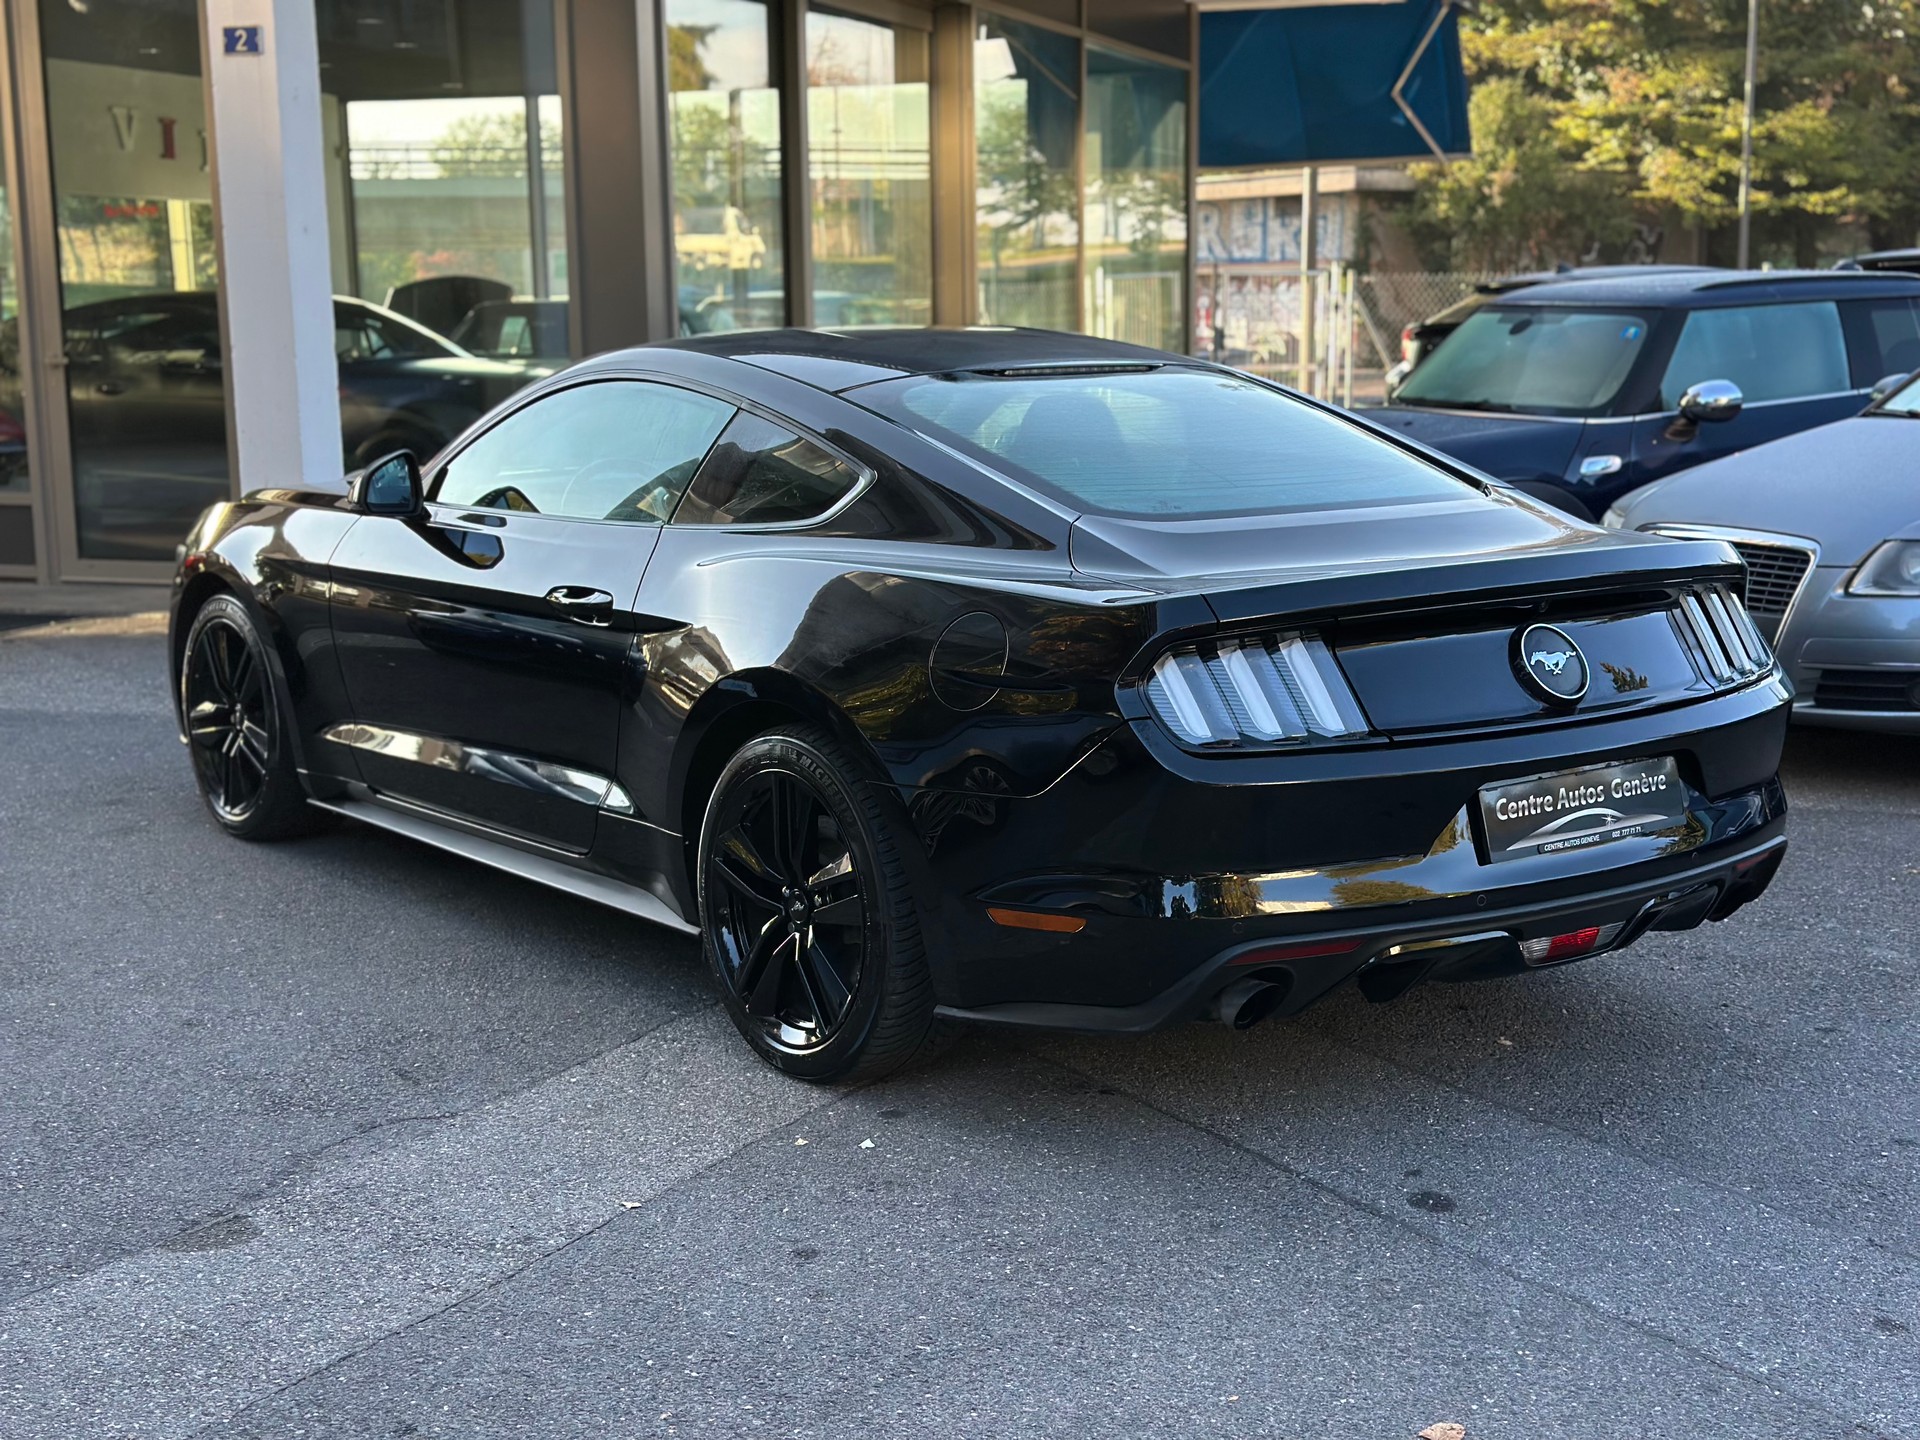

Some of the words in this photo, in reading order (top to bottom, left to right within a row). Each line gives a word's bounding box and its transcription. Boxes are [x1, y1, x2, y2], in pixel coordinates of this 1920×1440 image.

[234, 28, 249, 52] 2
[1495, 795, 1554, 821] Centre
[1557, 785, 1605, 810] Autos
[1610, 773, 1667, 799] Genève
[1544, 842, 1564, 851] CENTRE
[1564, 838, 1580, 848] AUTOS
[1580, 834, 1600, 844] GENEVE
[1621, 828, 1630, 836] 777
